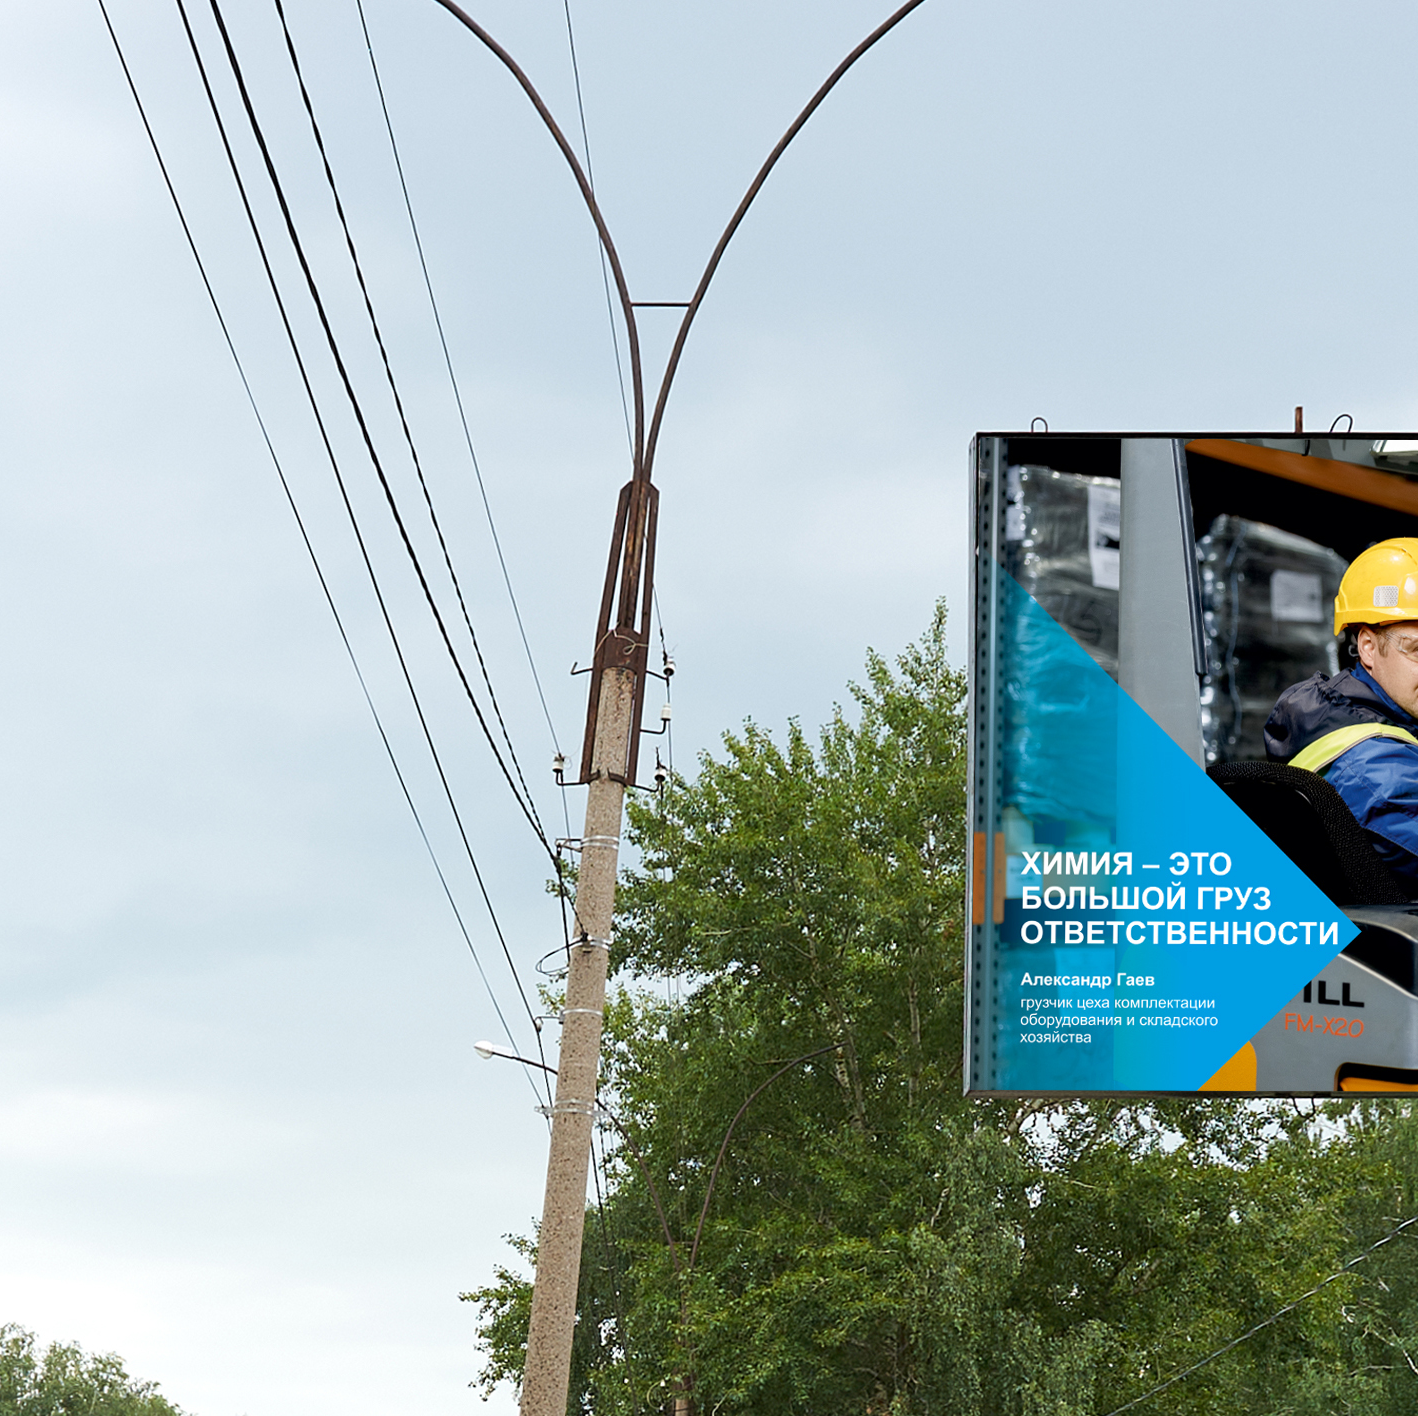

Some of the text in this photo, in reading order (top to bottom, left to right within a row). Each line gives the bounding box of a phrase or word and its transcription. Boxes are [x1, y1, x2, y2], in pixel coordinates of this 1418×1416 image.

[1020, 851, 1133, 876] ХИМИЯ
[1169, 852, 1232, 876] ЭТО
[1021, 881, 1271, 911] БОЛЬШОЙ ГРУЗ
[1020, 920, 1339, 946] ОТВЕТСТВЕННОСТИ
[1020, 972, 1155, 989] Александр Гаев
[1020, 998, 1216, 1011] грузчик цеха комплектации
[1020, 1013, 1219, 1029] оборудования и складского
[1285, 1012, 1365, 1038] FM-X20
[1020, 1032, 1092, 1044] хозяйства
